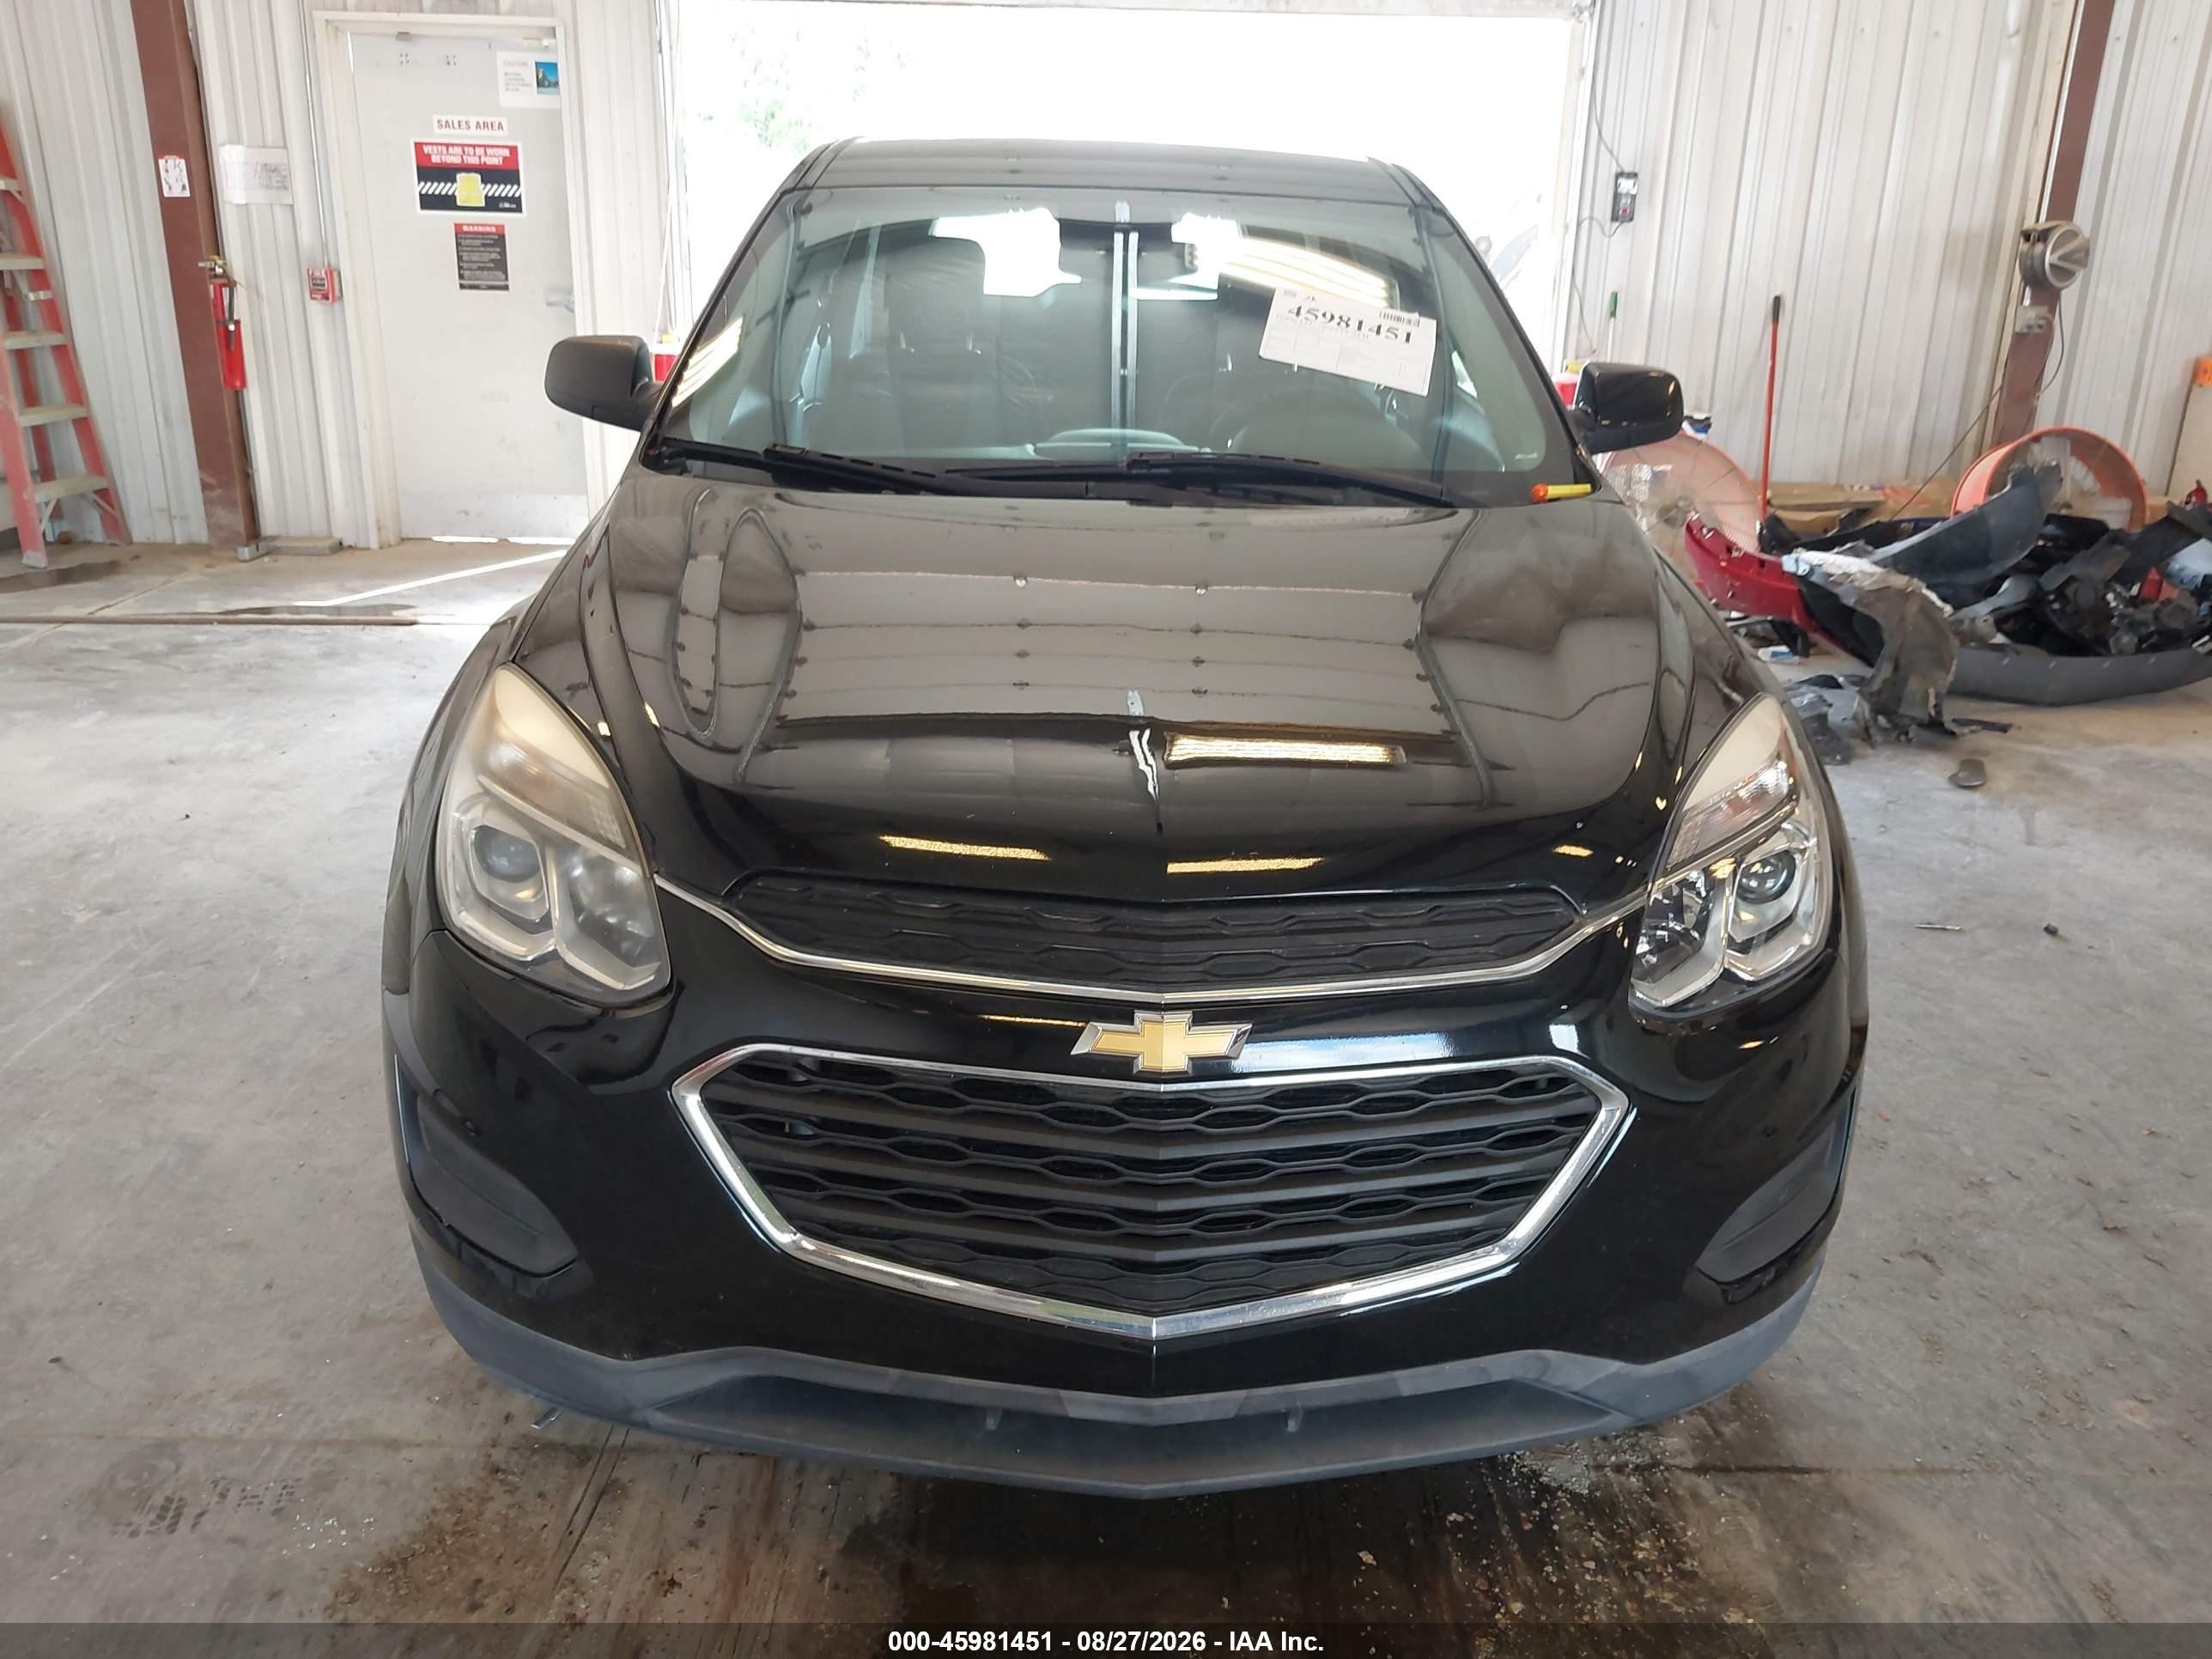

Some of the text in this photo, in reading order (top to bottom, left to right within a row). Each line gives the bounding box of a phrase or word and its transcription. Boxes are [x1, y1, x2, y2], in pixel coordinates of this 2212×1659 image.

[437, 119, 504, 131] SALES AREA
[422, 144, 447, 155] VESTS
[464, 146, 475, 155] TO
[431, 155, 503, 166] BEYOND THIS POINT
[1287, 305, 1413, 344] 45981451
